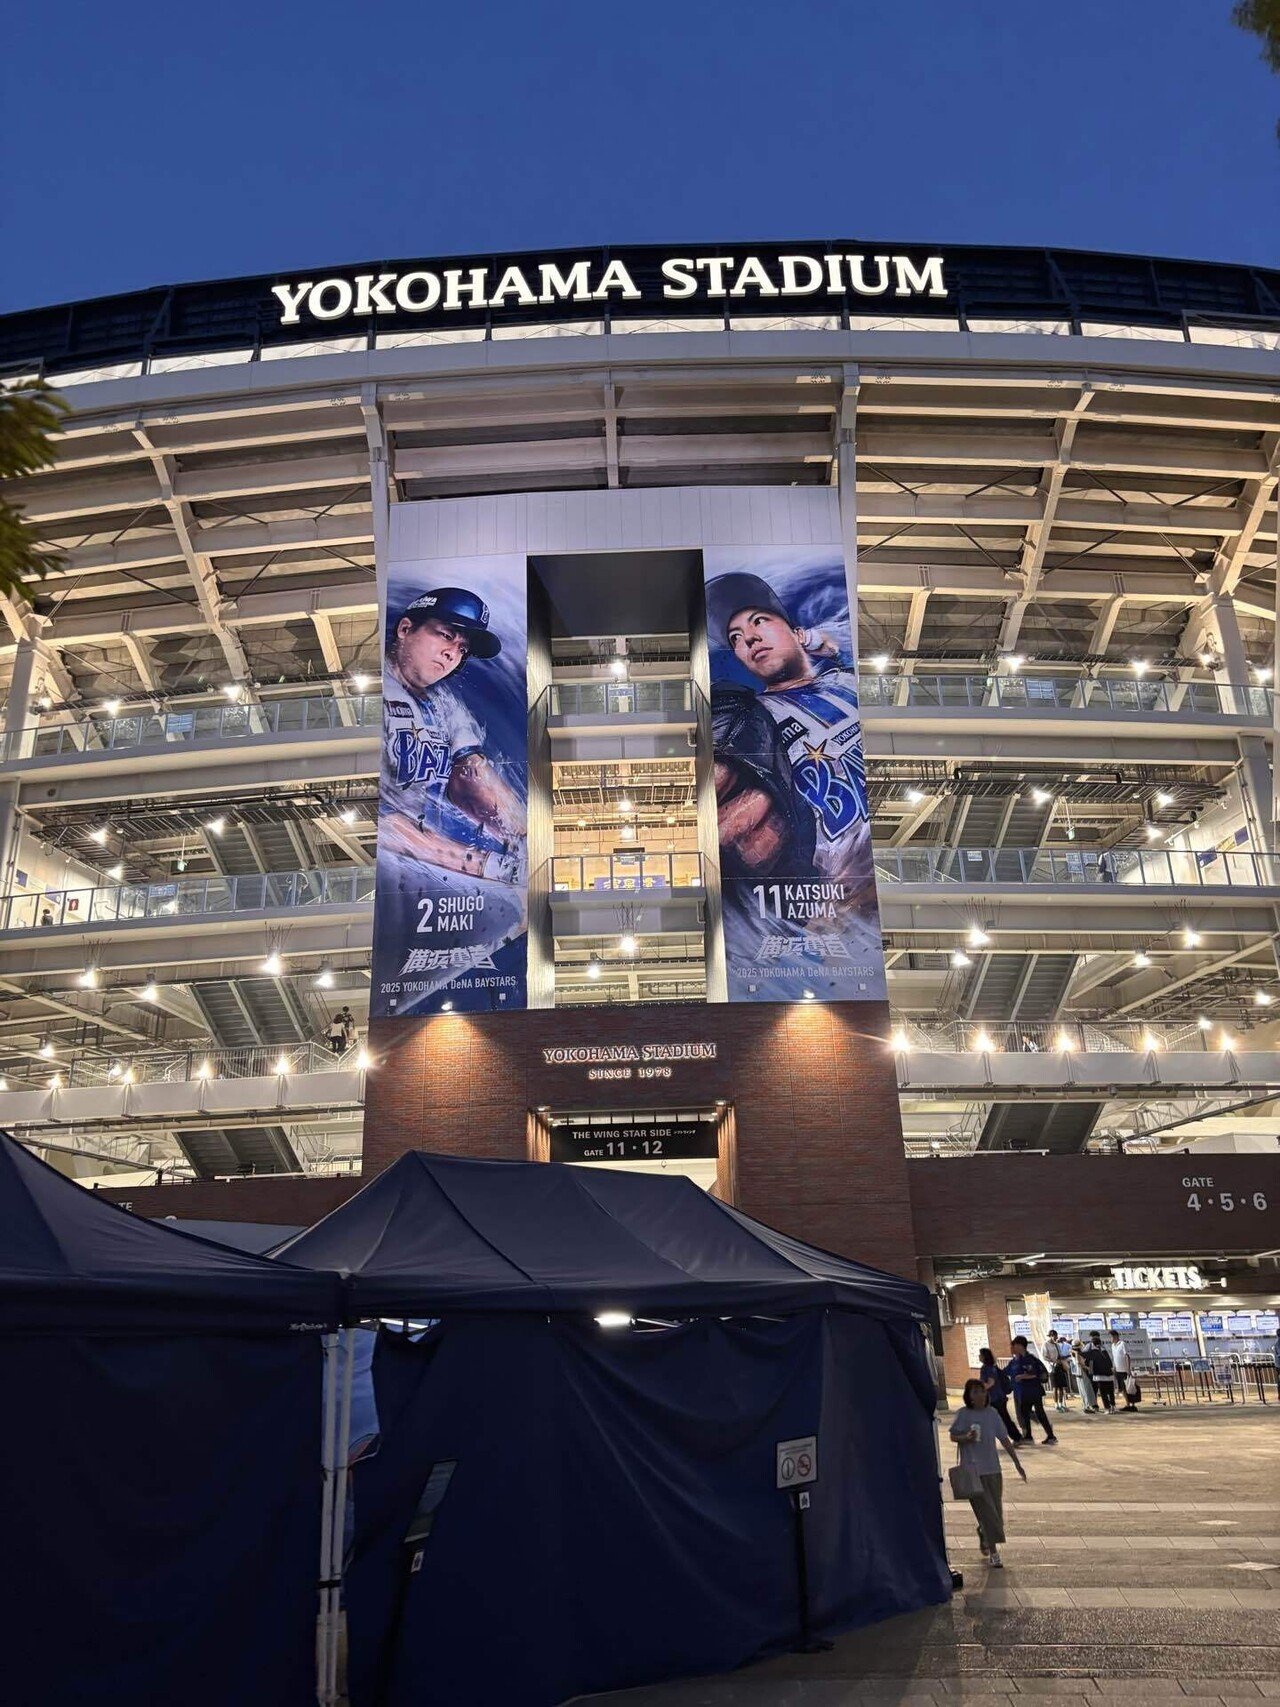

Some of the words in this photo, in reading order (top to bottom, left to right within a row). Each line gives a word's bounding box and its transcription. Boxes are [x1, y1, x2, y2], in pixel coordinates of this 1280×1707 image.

[271, 259, 642, 325] YOKOHAMA
[660, 255, 948, 299] STADIUM
[784, 884, 845, 900] KATSUKI
[438, 895, 484, 914] SHUGO
[753, 884, 782, 919] 11
[416, 898, 434, 933] 2
[787, 902, 837, 919] AZUMA
[437, 915, 474, 932] MAKI
[737, 967, 757, 978] 2025
[760, 966, 805, 978] YOKOHAMA
[808, 966, 830, 978] DeNA
[832, 966, 875, 977] BAYSTARS
[380, 982, 401, 994] 2025
[402, 980, 448, 992] YOKOHAMA
[450, 979, 473, 990] DeNA
[475, 976, 517, 989] BAYSTARS
[543, 1046, 639, 1064] YOKOHAMA
[641, 1042, 717, 1060] STADIUM
[588, 1067, 632, 1080] SINCE
[638, 1066, 673, 1078] 1978
[572, 1131, 590, 1139] THE
[593, 1130, 620, 1138] WING
[623, 1129, 646, 1138] STAR
[649, 1128, 672, 1137] SIDE
[583, 1149, 604, 1157] GATE
[1182, 1177, 1214, 1188] GATE
[1111, 1266, 1203, 1290] TICKETS
